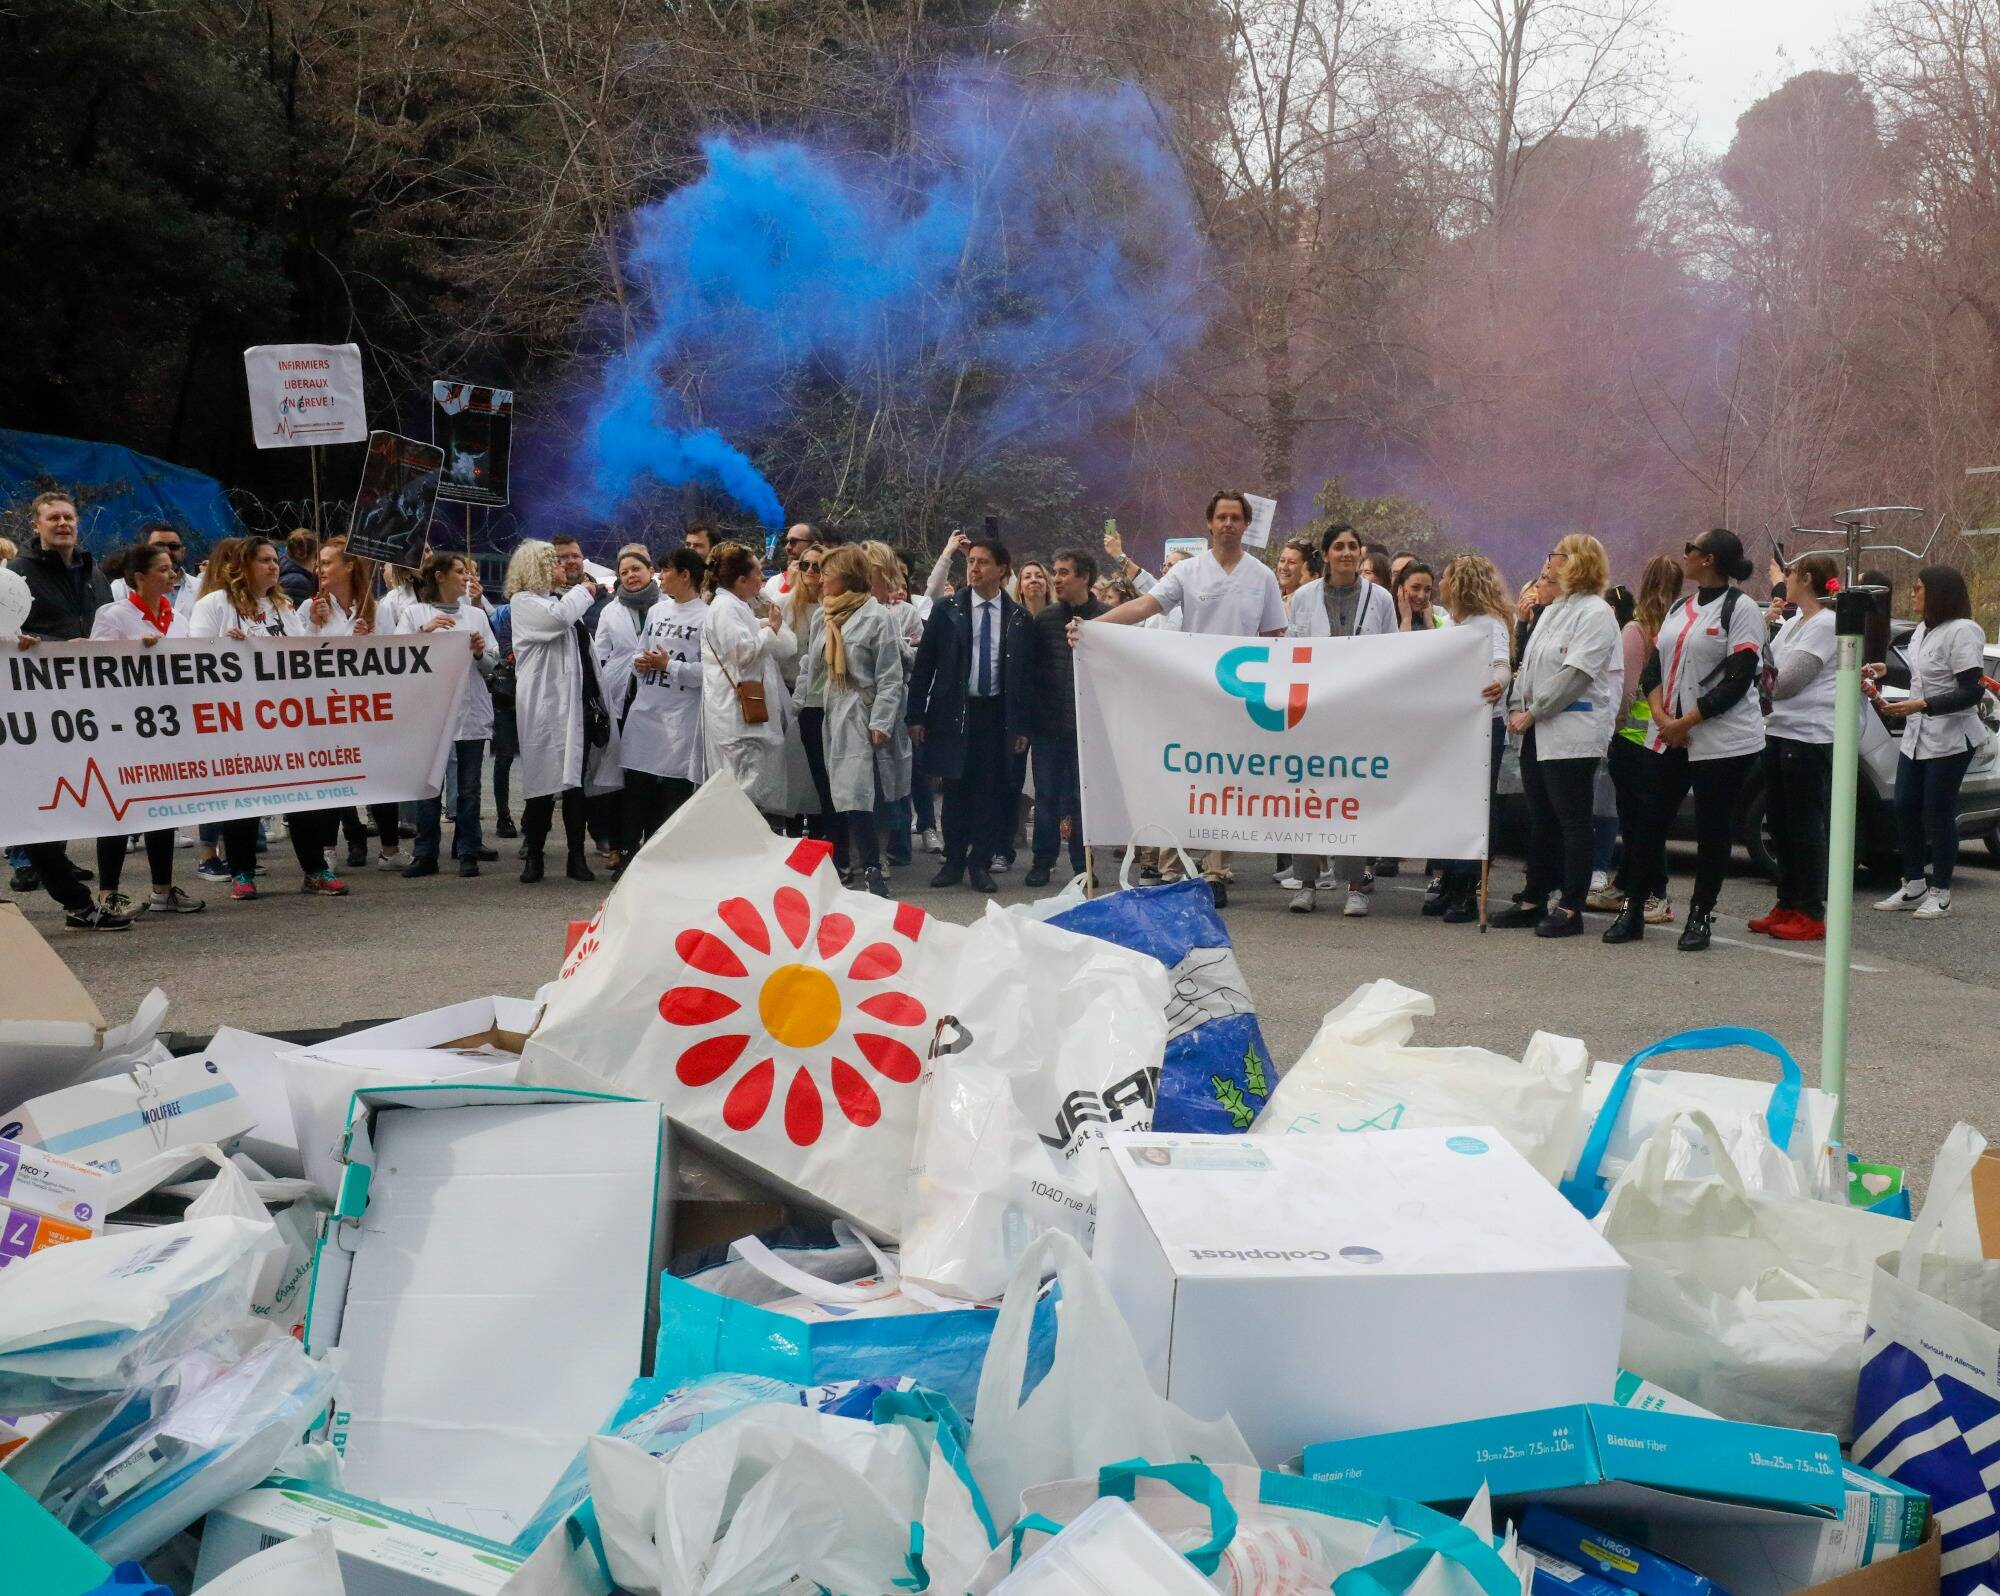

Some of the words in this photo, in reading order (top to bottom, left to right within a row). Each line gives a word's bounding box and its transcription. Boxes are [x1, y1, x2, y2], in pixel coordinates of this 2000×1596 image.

[278, 359, 330, 371] INFIRMIERS
[8, 651, 243, 691] INFIRMIERS
[254, 642, 434, 682] LIBÉRAUX
[51, 708, 99, 743] 06
[134, 704, 181, 739] 83
[192, 701, 244, 735] EN
[255, 689, 394, 731] COLÈRE
[118, 761, 208, 786] INFIRMIERS
[211, 753, 281, 777] LIBÉRAUX
[286, 751, 304, 770] EN
[308, 745, 362, 769] COLÈRE
[1163, 742, 1390, 783] Convergence
[147, 799, 229, 819] COLLECTIF
[233, 791, 315, 810] ASYNDICAL
[1188, 785, 1361, 820] infirmière
[1264, 831, 1314, 844] AVANT
[1319, 833, 1358, 845] TOUT
[141, 1100, 183, 1126] MOLIFREE
[20, 1163, 39, 1176] PICO
[43, 1171, 49, 1179] 7
[1031, 1180, 1064, 1203] 1040
[1063, 1197, 1084, 1211] rue
[1189, 1247, 1331, 1263] Coloplast
[1945, 1353, 1953, 1361] en
[1954, 1356, 1986, 1377] Allemagne
[1606, 1433, 1645, 1450] Biatain
[1646, 1439, 1667, 1452] Fiber
[1344, 1467, 1364, 1479] Fiber
[1601, 1537, 1632, 1557] URGO
